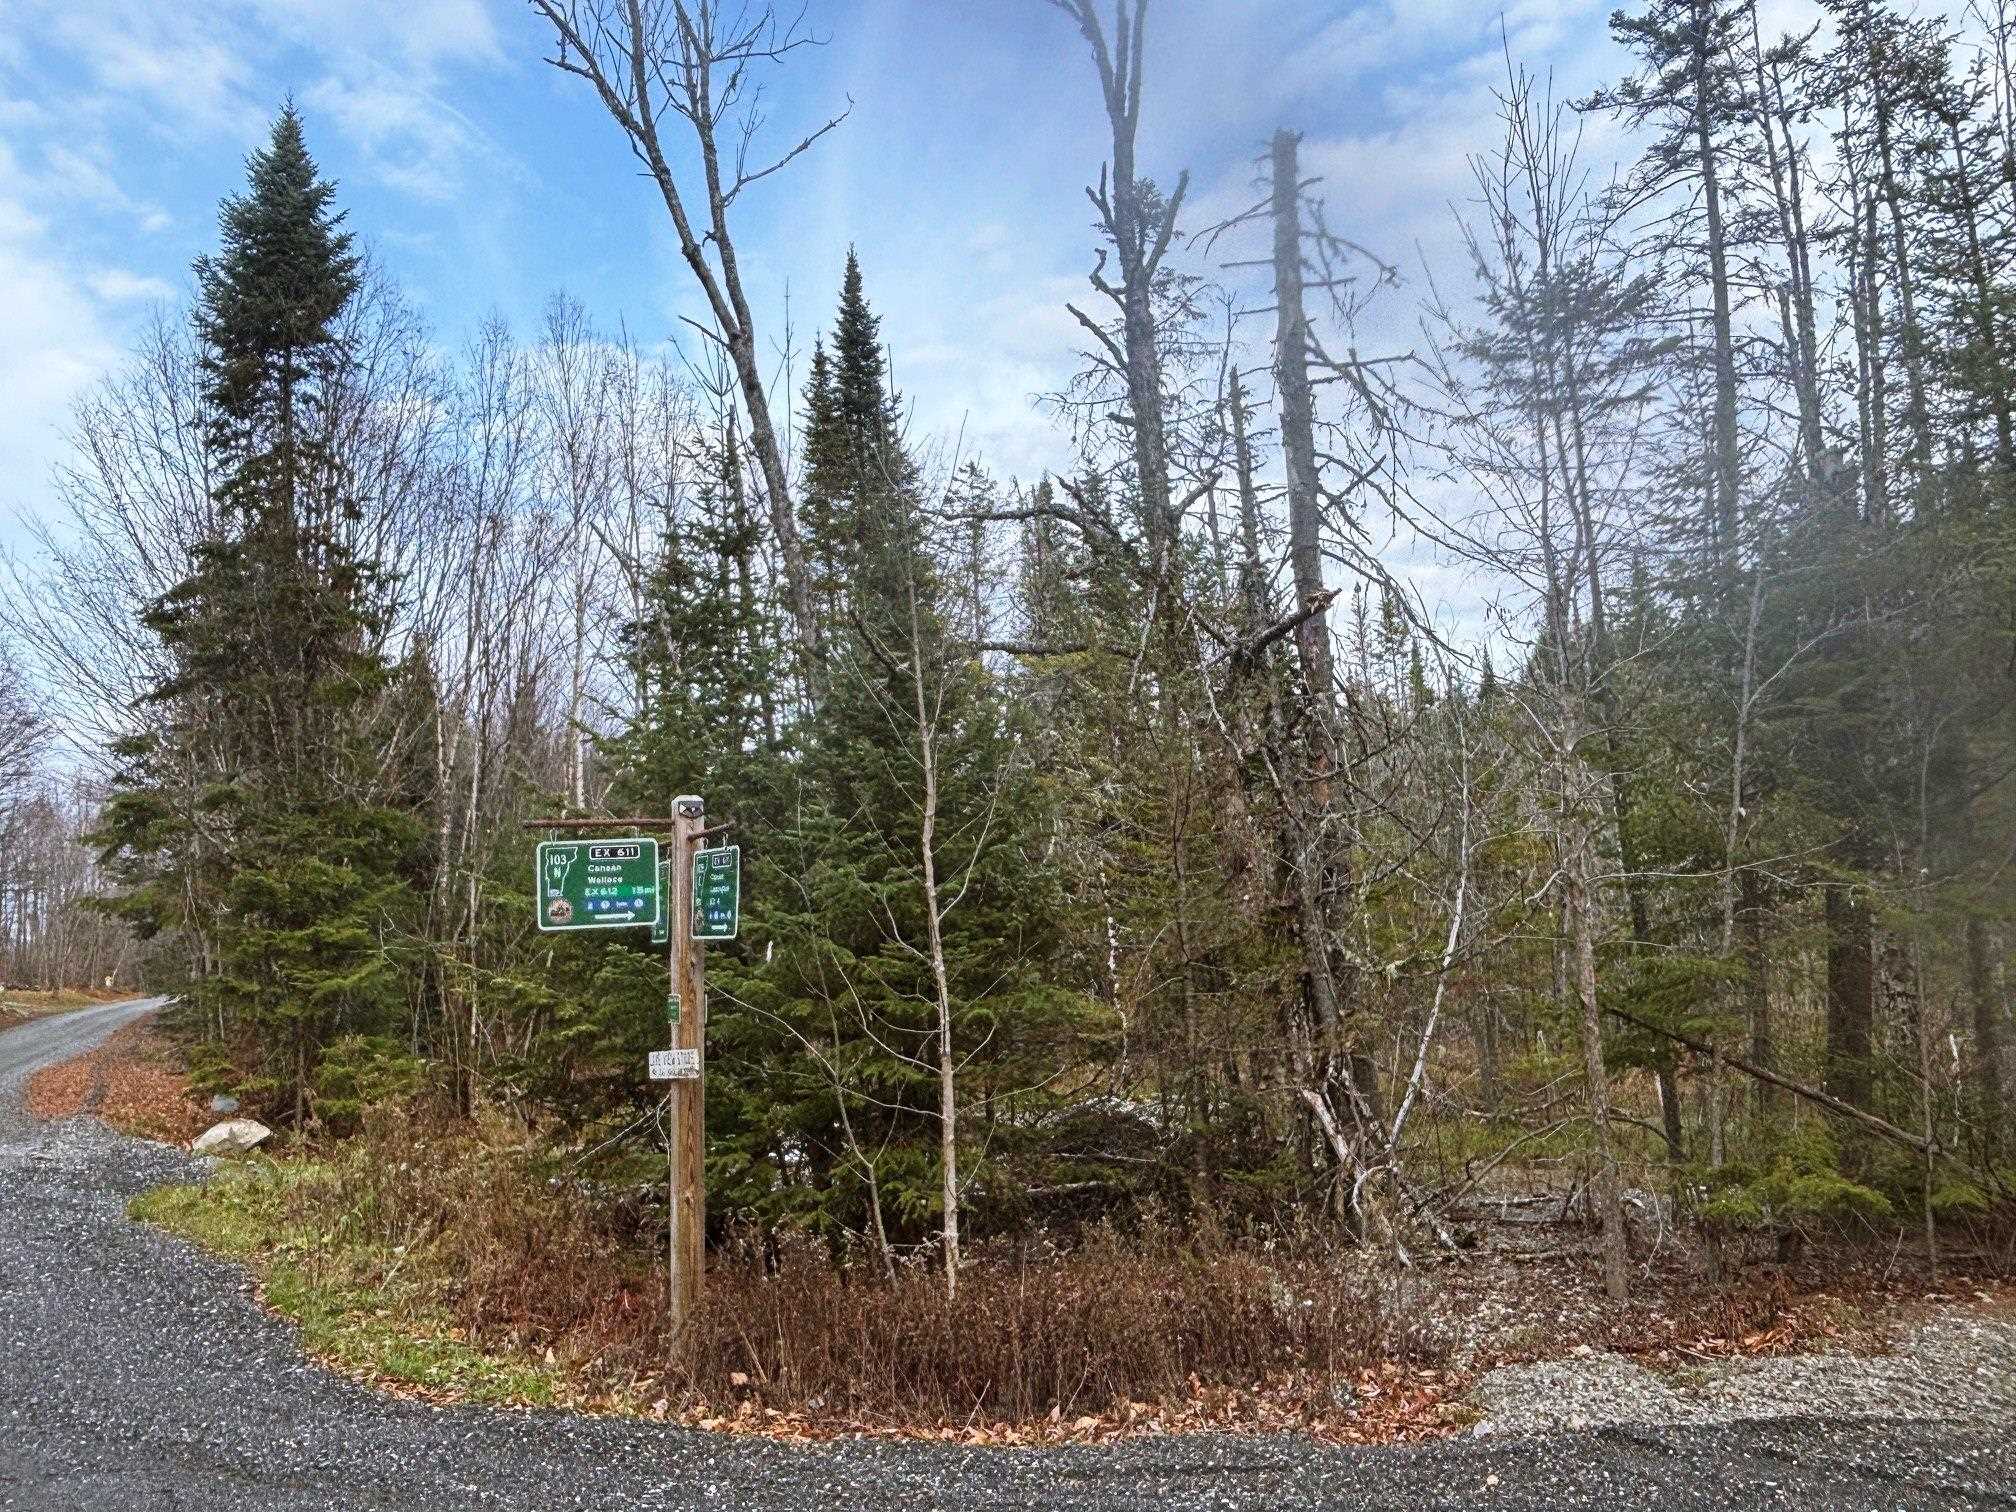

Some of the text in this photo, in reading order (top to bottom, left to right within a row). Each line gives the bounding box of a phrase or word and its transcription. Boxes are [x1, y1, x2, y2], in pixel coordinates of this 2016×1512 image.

[595, 847, 635, 857] EX 611
[550, 854, 567, 865] 103
